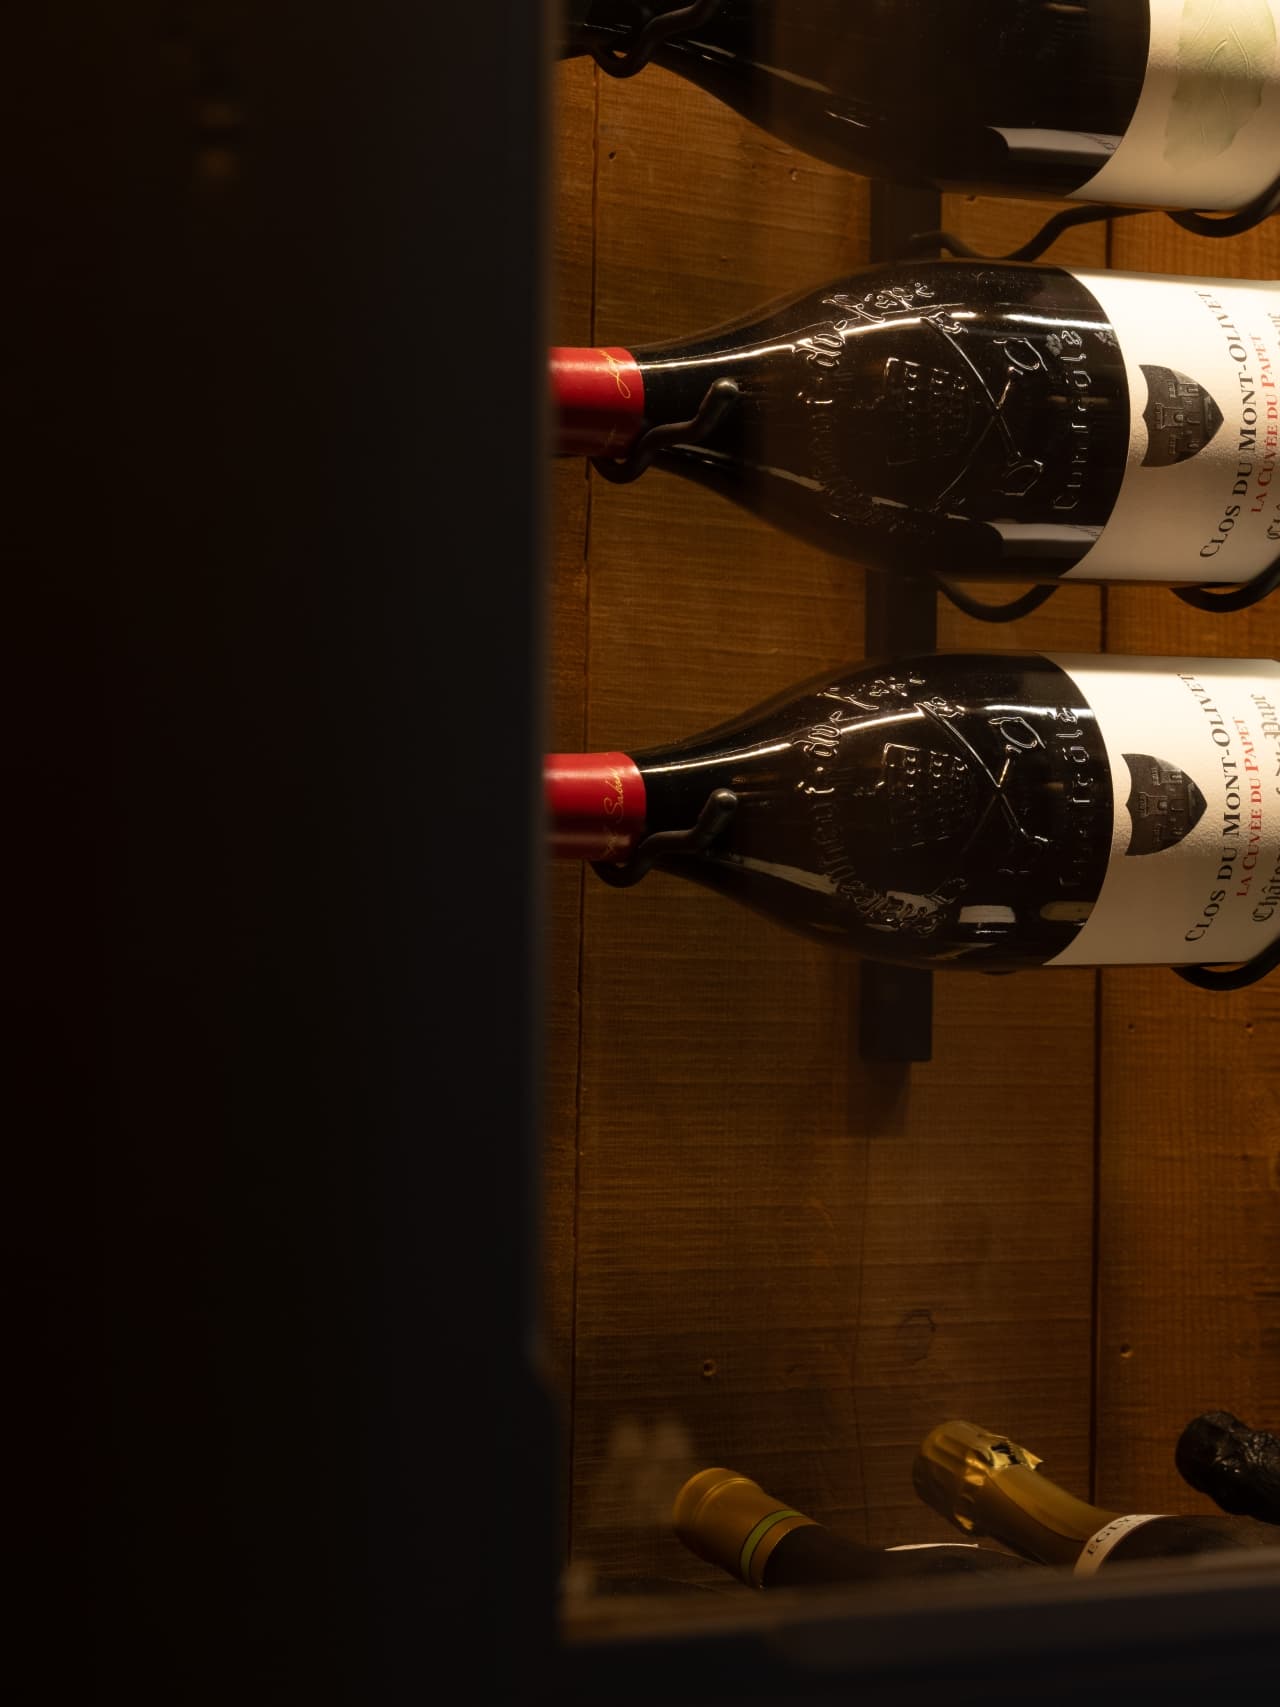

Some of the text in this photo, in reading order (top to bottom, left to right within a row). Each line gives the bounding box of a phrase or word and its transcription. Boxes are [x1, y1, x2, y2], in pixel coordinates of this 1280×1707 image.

[1249, 332, 1276, 388] PAPET
[1194, 290, 1258, 558] CLOS DU MONT-OLIVET
[1266, 393, 1280, 420] DU
[1250, 492, 1268, 513] LA
[1232, 716, 1259, 773] PAPET
[1177, 673, 1241, 942] CLOS DU MONT-OLIVET
[1249, 779, 1263, 806] DU
[1235, 876, 1253, 896] LA
